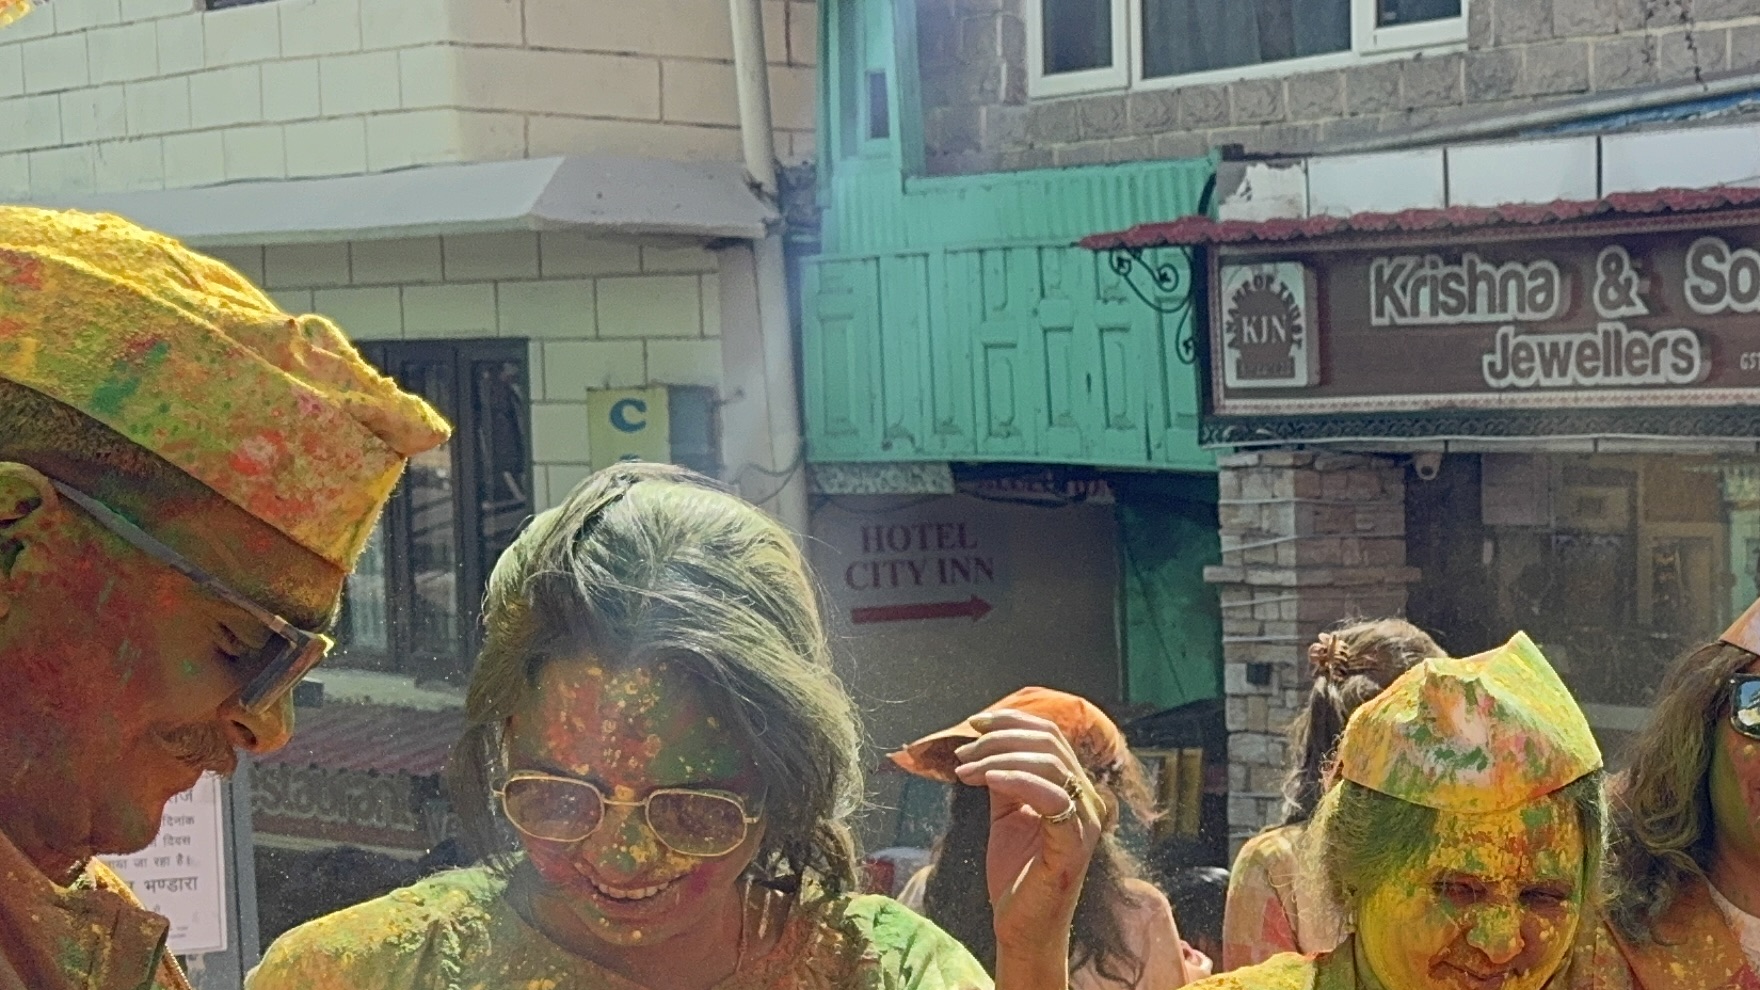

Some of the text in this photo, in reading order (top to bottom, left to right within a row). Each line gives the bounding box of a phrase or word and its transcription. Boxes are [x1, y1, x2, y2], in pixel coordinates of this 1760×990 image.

[1369, 256, 1562, 327] Krishna
[1594, 246, 1650, 317] &
[1242, 315, 1286, 343] KJN
[1483, 327, 1703, 387] Jewellers
[861, 522, 977, 553] HOTEL
[844, 556, 994, 590] CITY INN
